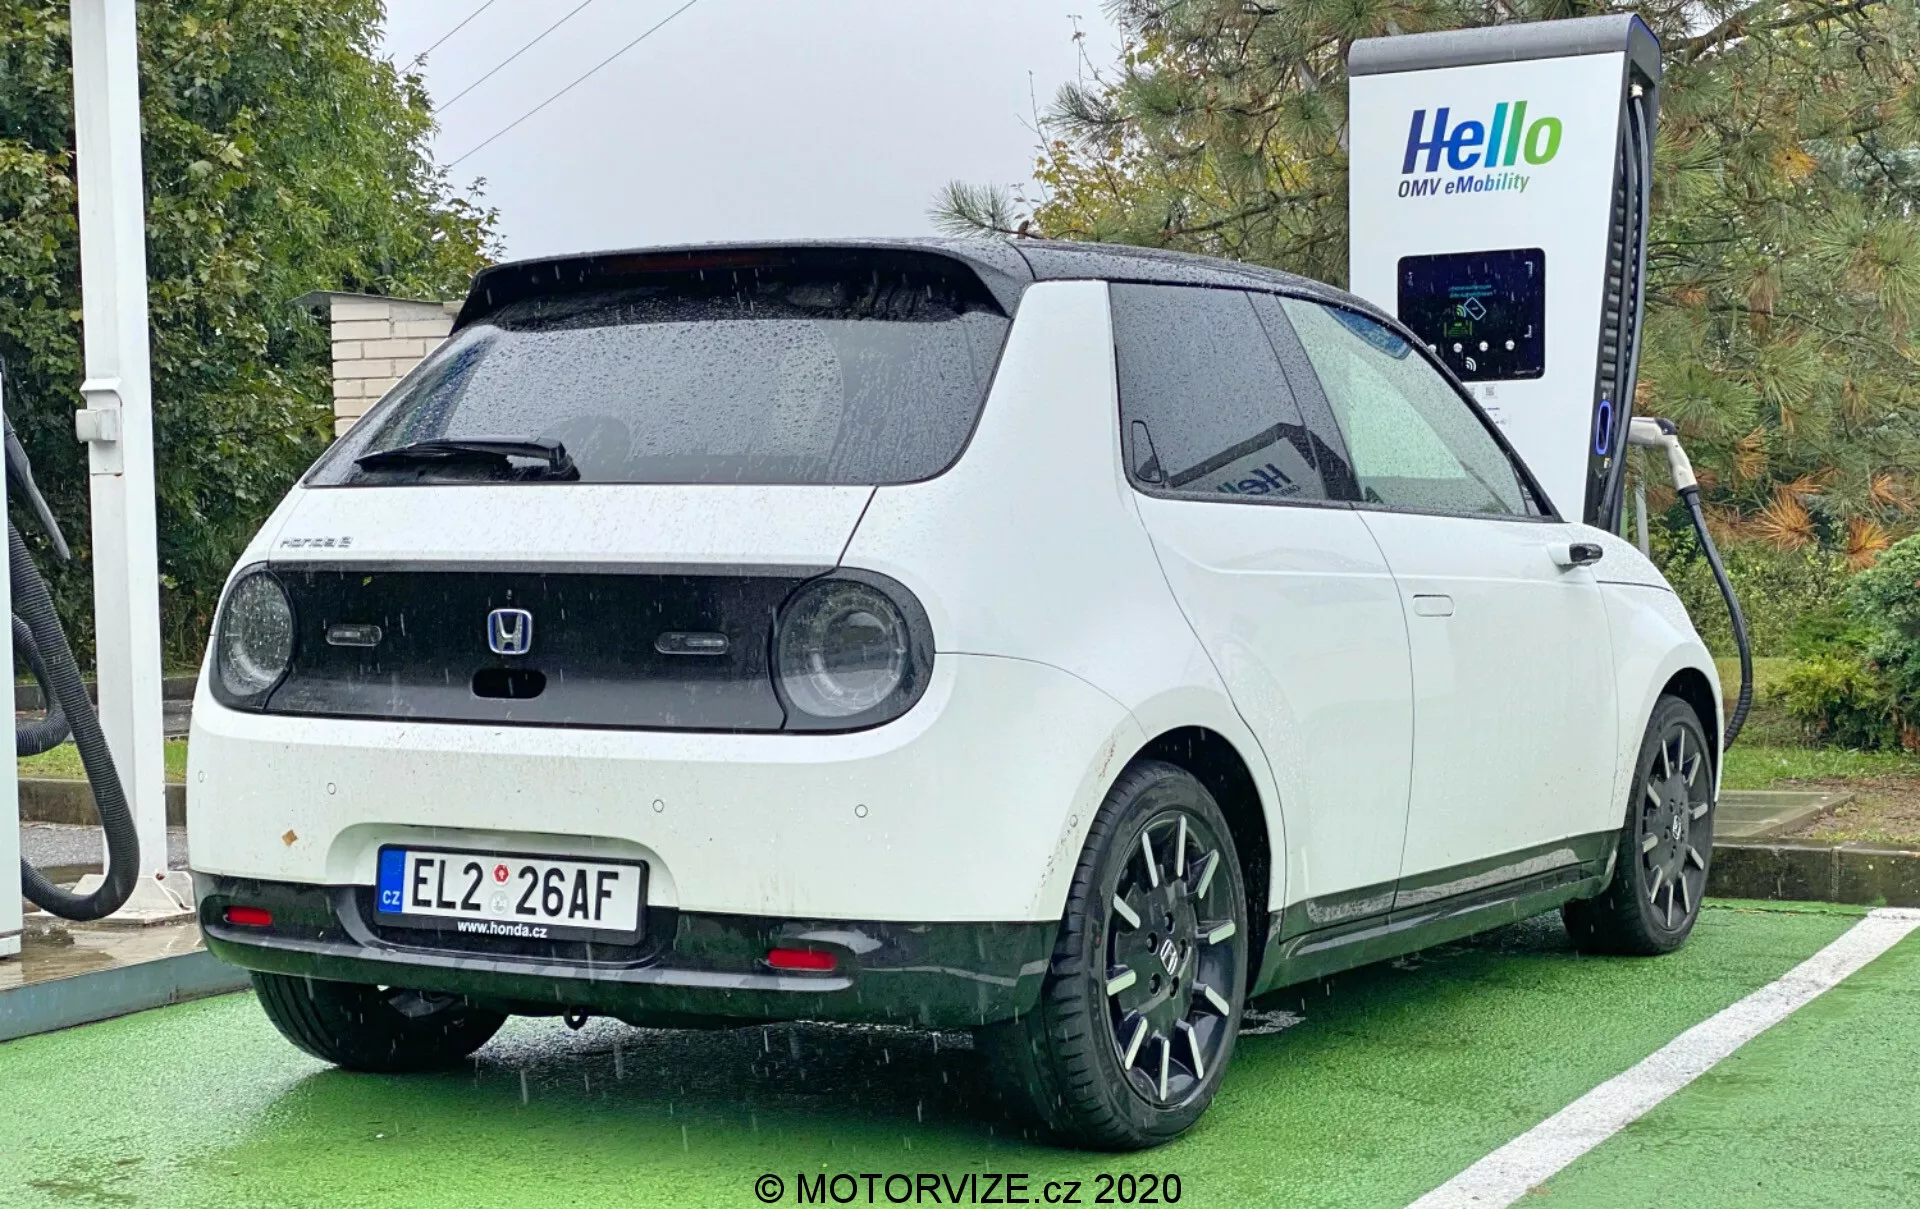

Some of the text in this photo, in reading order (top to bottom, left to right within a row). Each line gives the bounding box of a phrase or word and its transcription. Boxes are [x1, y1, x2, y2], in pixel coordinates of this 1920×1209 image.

[1401, 100, 1563, 175] Hello
[1397, 173, 1530, 198] OMV eMobility
[382, 889, 400, 906] CZ
[412, 858, 619, 921] EL2 26AF
[456, 920, 548, 939] www.honda.cz
